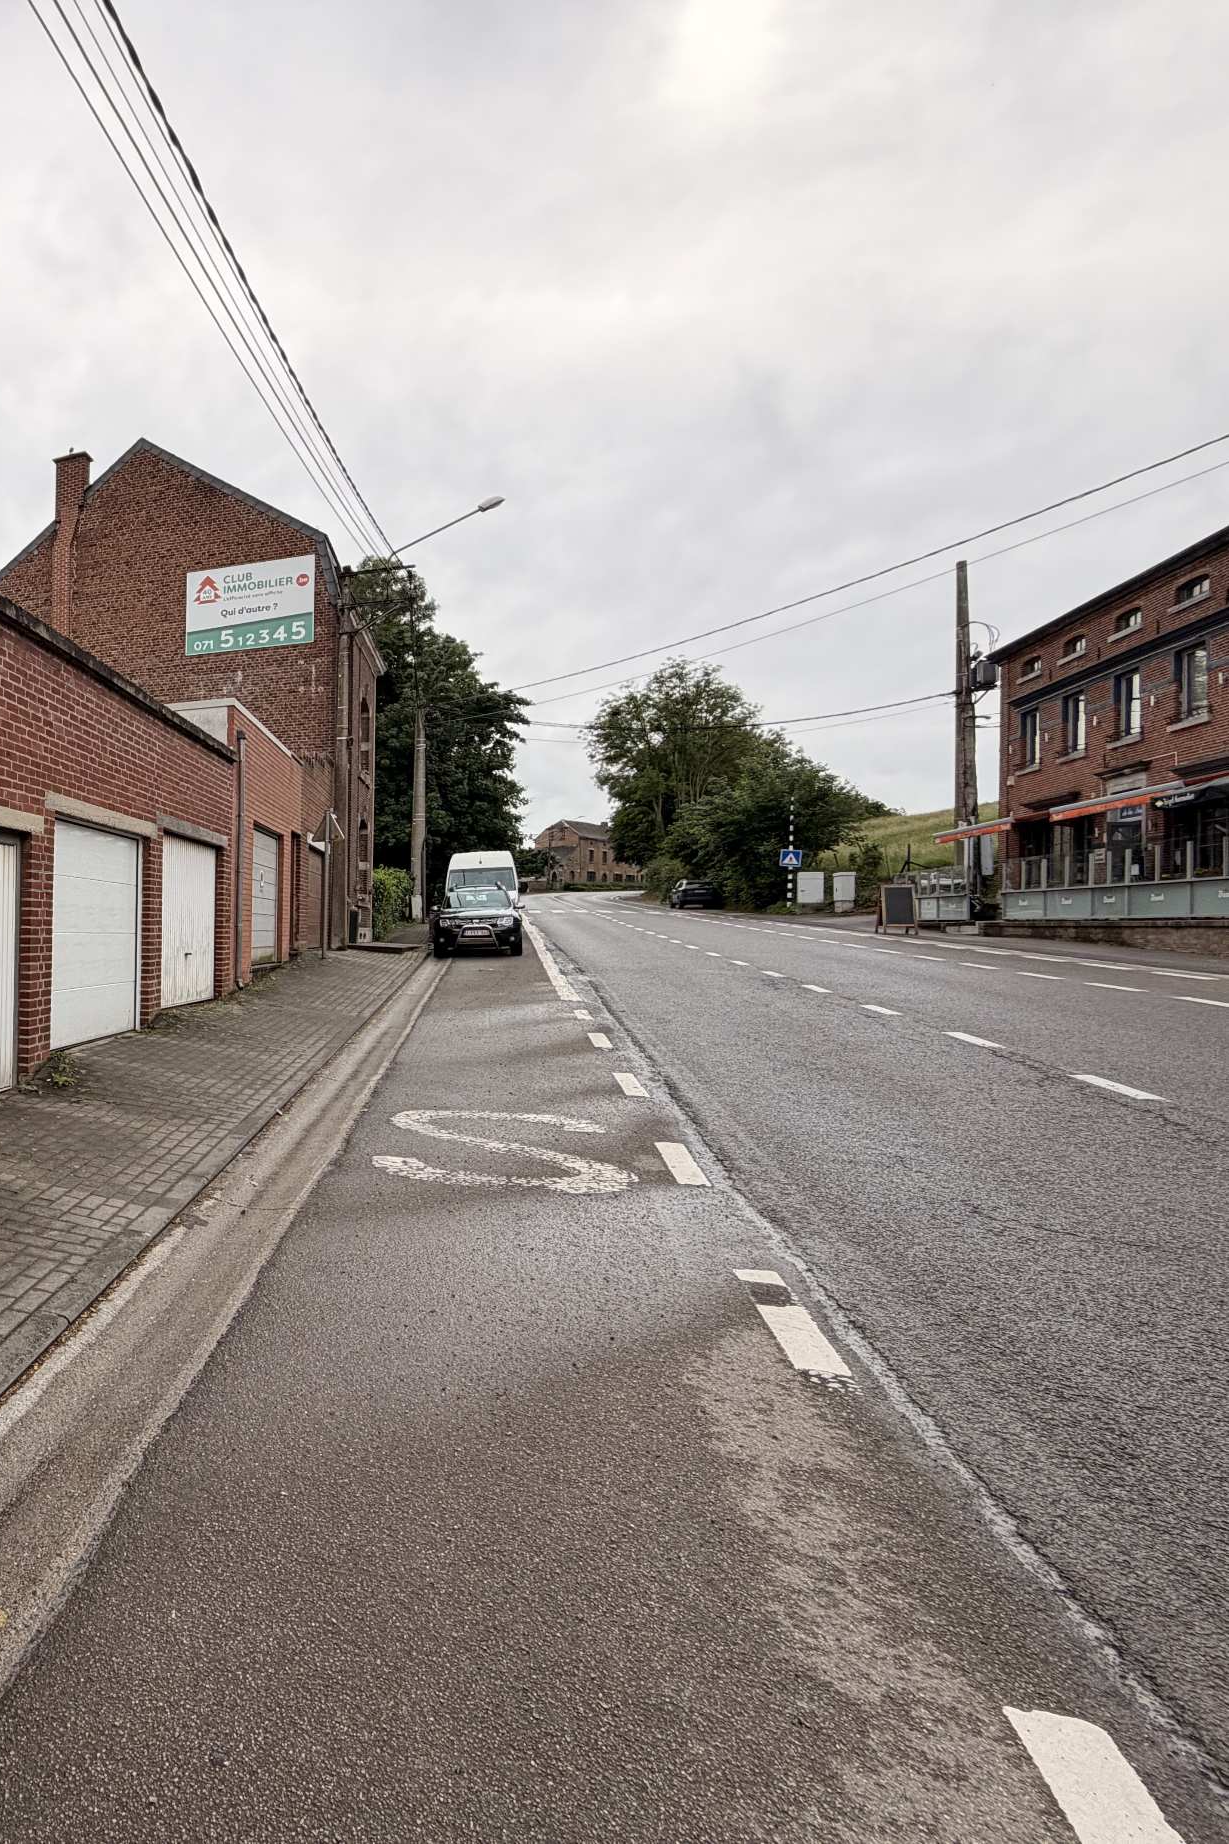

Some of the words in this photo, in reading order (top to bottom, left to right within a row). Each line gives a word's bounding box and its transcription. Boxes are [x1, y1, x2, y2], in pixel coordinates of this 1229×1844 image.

[223, 572, 253, 584] CLUB
[223, 576, 293, 594] IMMOBILIER
[221, 608, 236, 618] Qui
[238, 605, 271, 615] d'autre
[194, 640, 214, 651] 071
